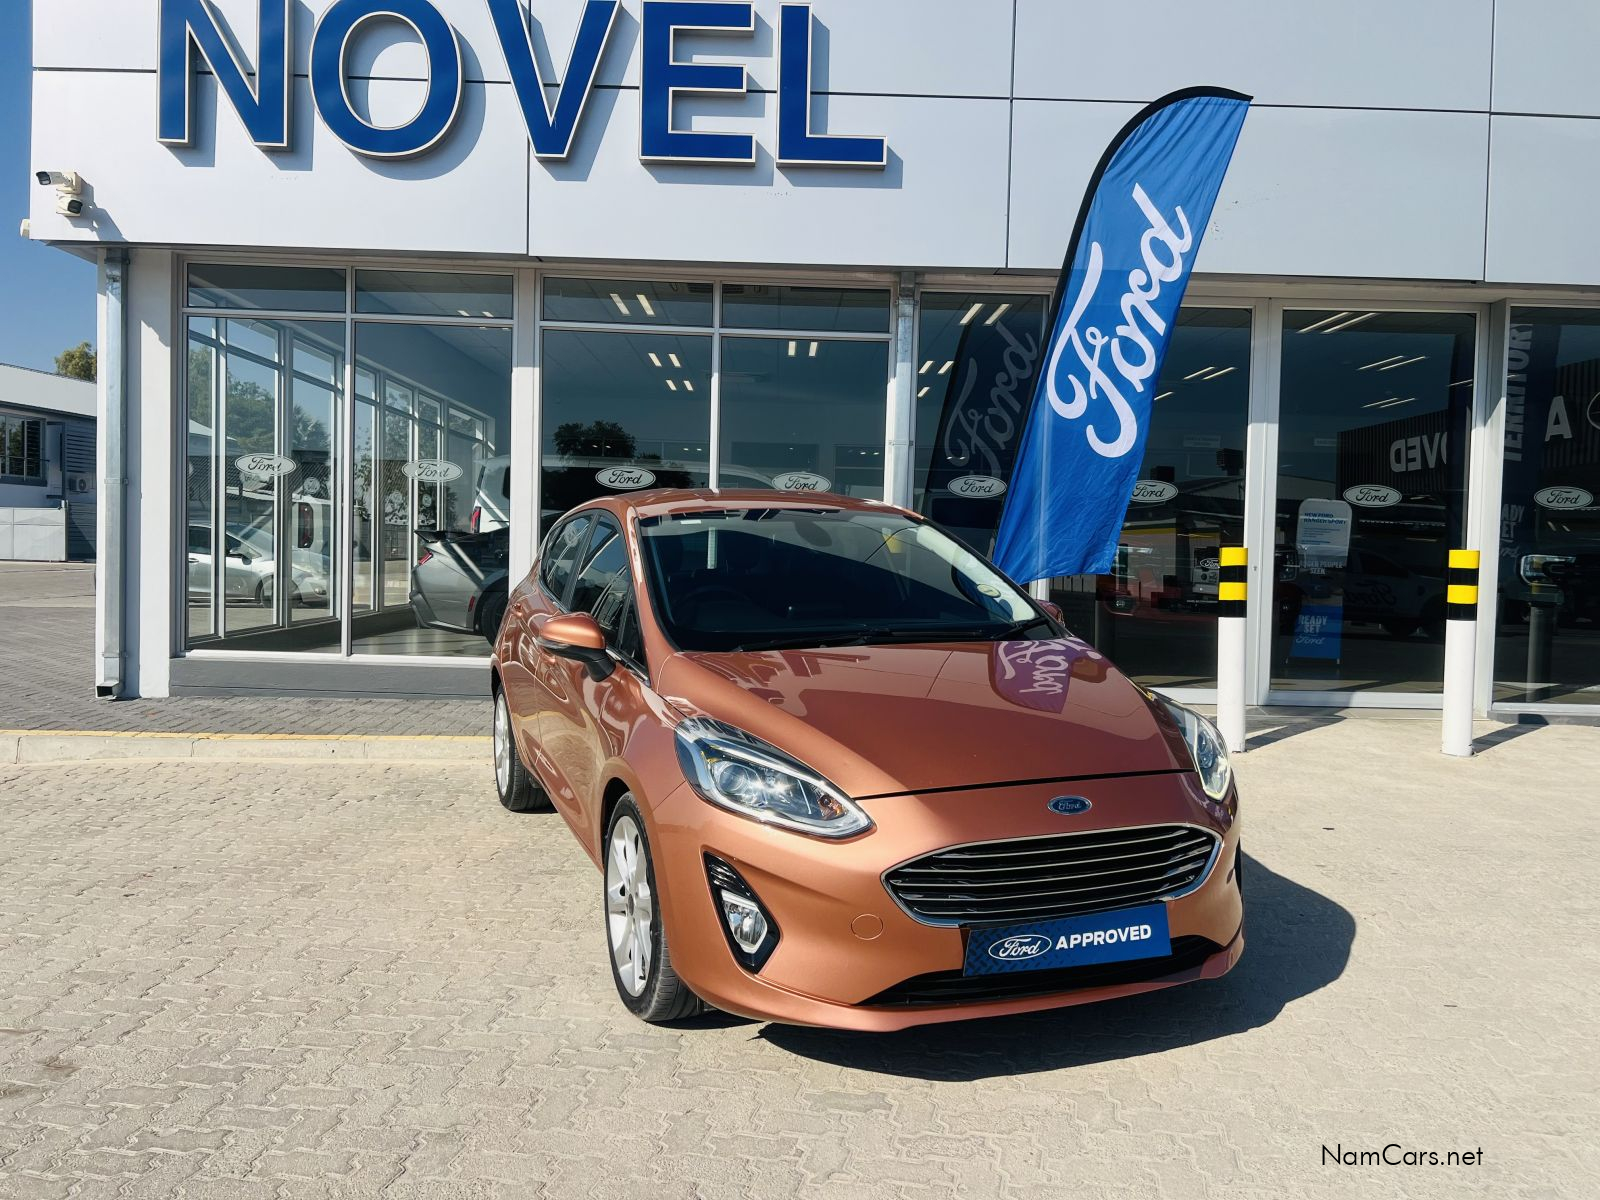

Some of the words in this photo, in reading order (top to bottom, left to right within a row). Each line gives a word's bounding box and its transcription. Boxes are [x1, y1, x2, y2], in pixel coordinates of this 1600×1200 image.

[156, 0, 889, 170] NOVEL
[1046, 182, 1193, 458] Ford
[944, 320, 1038, 477] Ford
[247, 456, 282, 471] Ford
[417, 462, 450, 478] Ford
[608, 469, 643, 485] Ford
[784, 475, 819, 491] Ford
[960, 478, 994, 494] Ford
[1132, 484, 1166, 498] Ford
[1355, 487, 1390, 503] Ford
[1546, 489, 1581, 505] Ford
[1501, 503, 1525, 522] ADY
[1501, 521, 1517, 538] ET
[1298, 614, 1328, 626] READY
[1304, 624, 1321, 634] SET
[999, 937, 1042, 958] Ford
[1055, 924, 1152, 950] APPROVED
